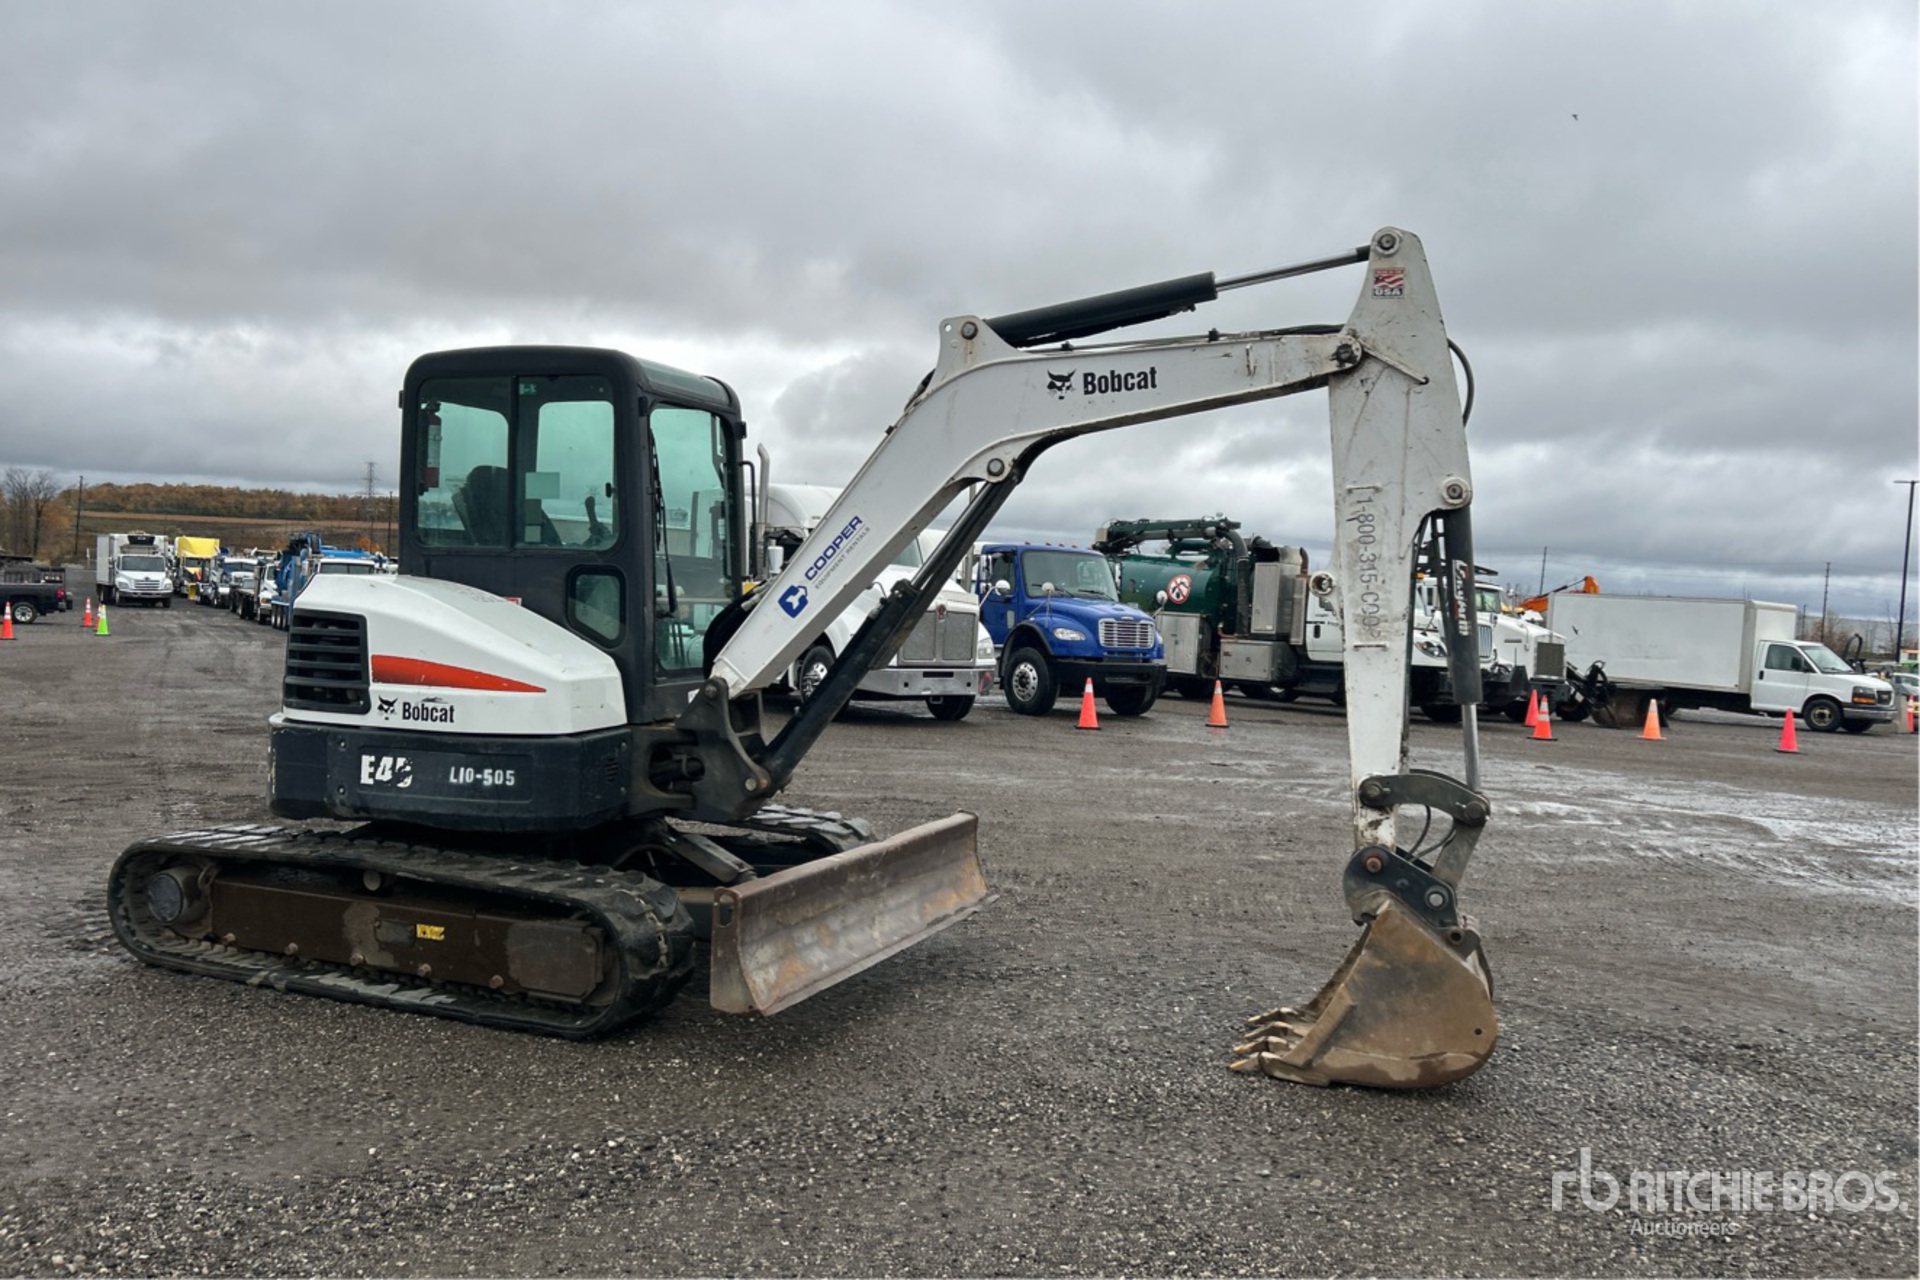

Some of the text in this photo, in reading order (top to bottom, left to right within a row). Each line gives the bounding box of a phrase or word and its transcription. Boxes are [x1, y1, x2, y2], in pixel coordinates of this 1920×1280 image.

[1375, 288, 1401, 296] USA
[1083, 366, 1157, 395] Bobcat
[805, 515, 863, 581] COOPER
[815, 526, 871, 589] EQUIPMENT RENTALS
[402, 701, 455, 723] Bobcat
